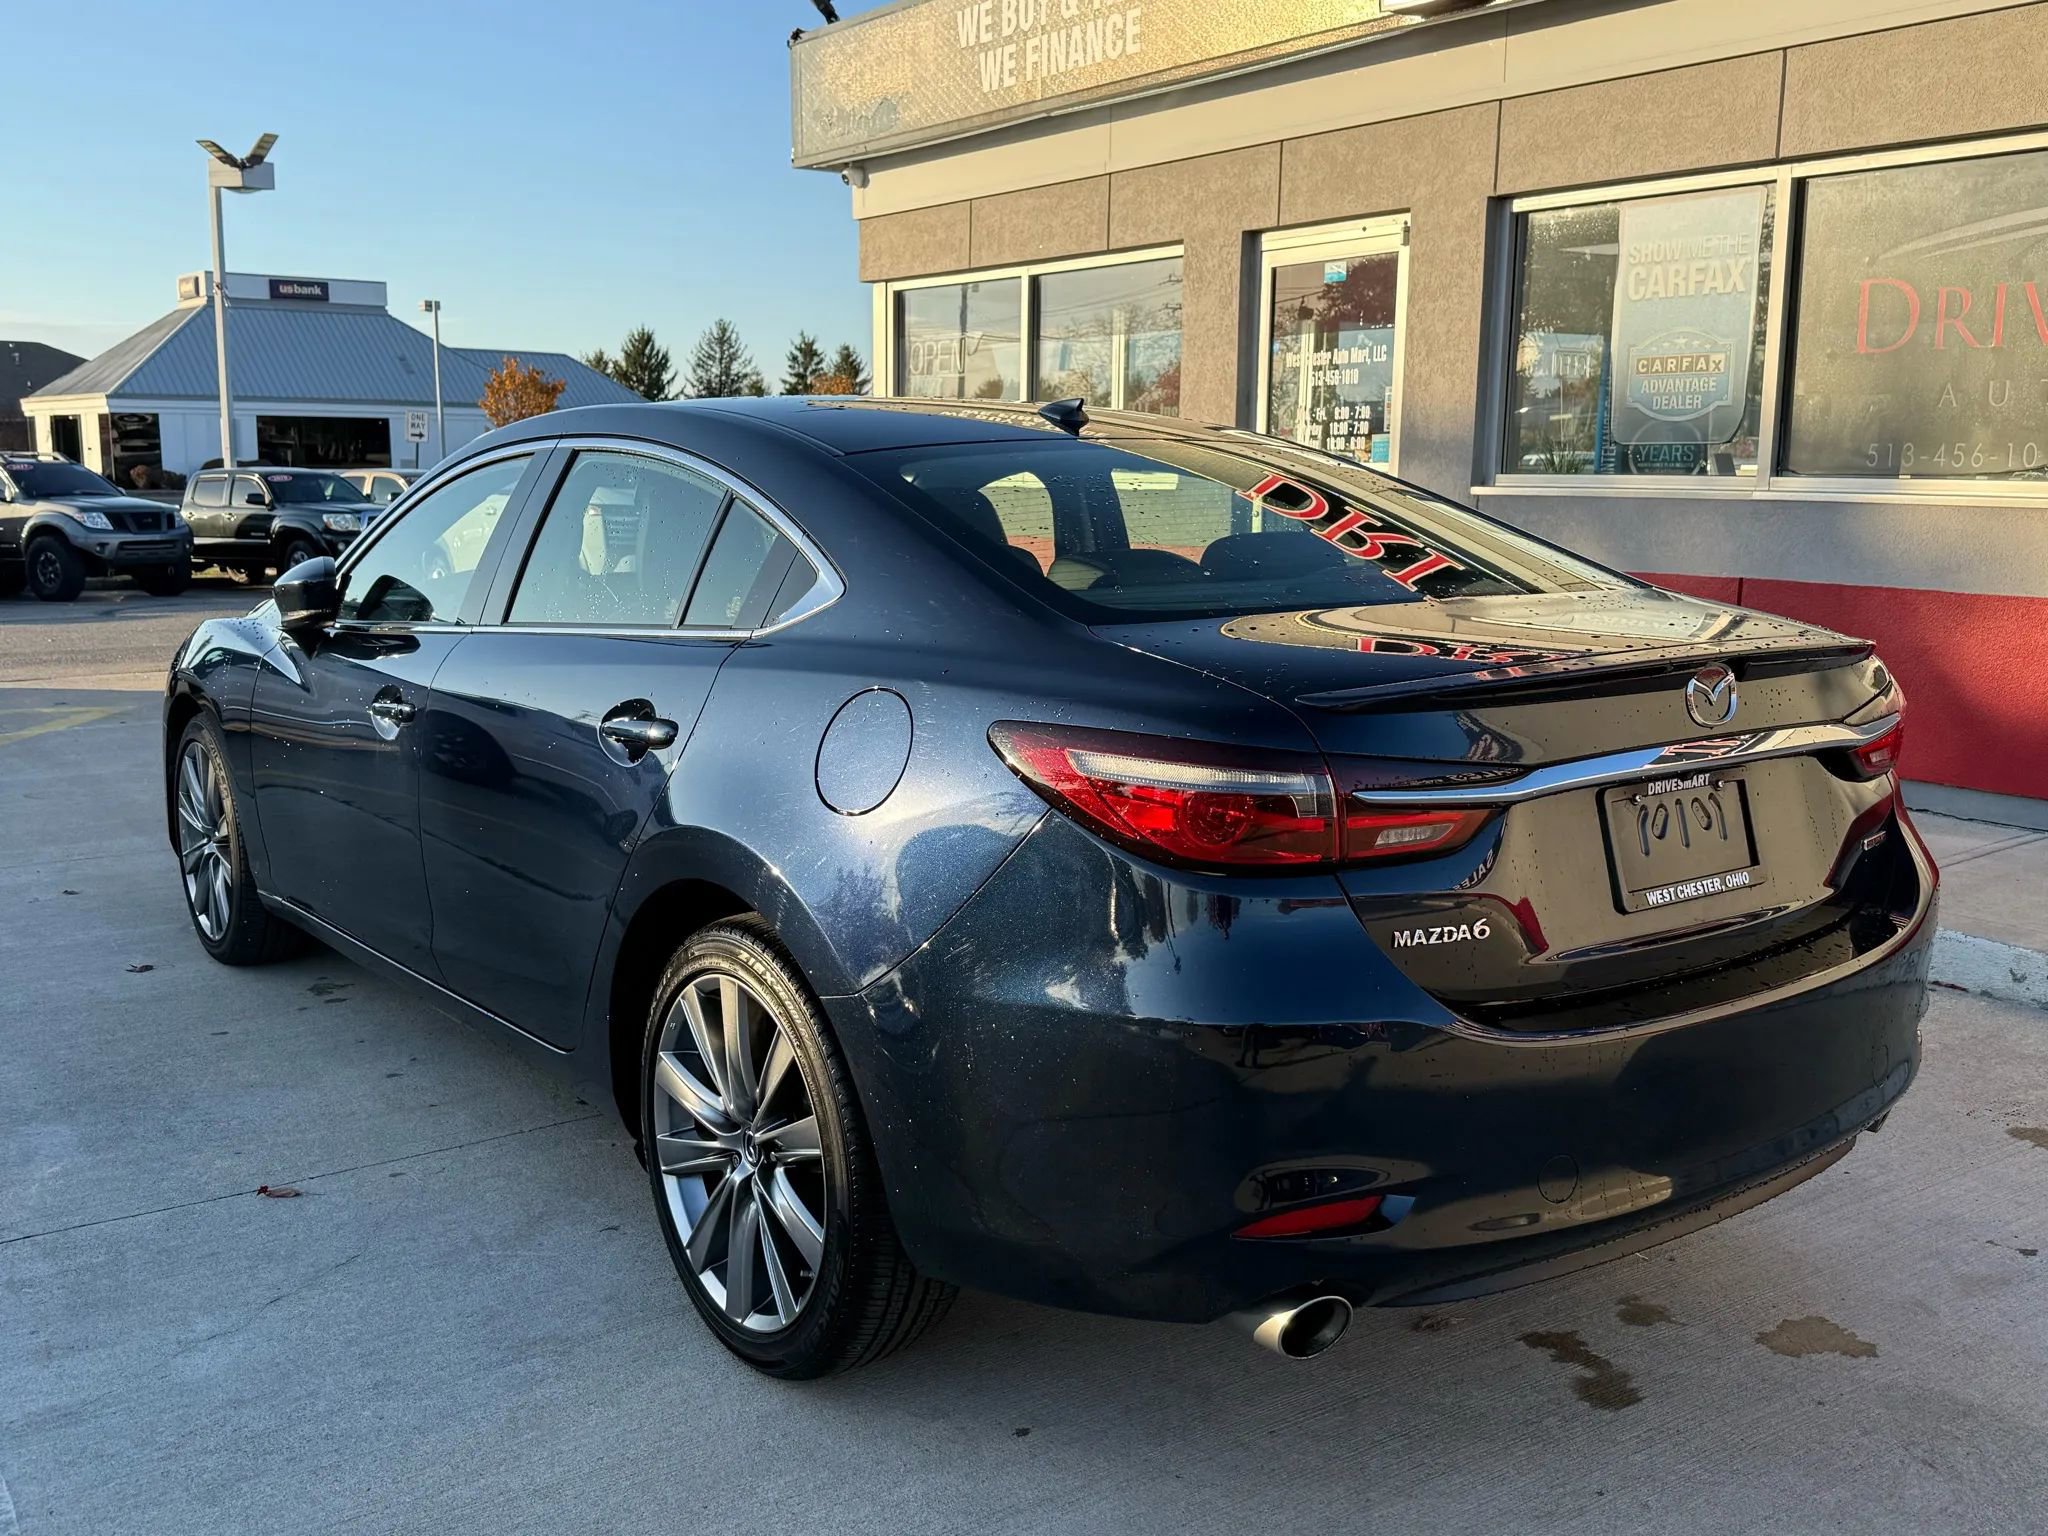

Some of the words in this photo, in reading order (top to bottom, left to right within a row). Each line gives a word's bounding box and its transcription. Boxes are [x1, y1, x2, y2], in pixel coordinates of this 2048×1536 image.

[957, 3, 993, 49] WE
[1001, 0, 1047, 37] BUY
[979, 43, 1017, 93] WE
[1025, 8, 1142, 82] FINANCE
[1628, 240, 1681, 265] SHOW
[1688, 236, 1712, 259] ME
[1715, 233, 1749, 256] THE
[1627, 257, 1752, 301] CARFAX
[910, 340, 966, 375] OPEN
[1373, 344, 1387, 362] LLC
[1638, 357, 1722, 373] CARFAX
[1641, 377, 1717, 394] ADVANTAGE
[1652, 394, 1702, 410] DEALER
[1640, 445, 1694, 461] YEARS
[1866, 443, 2037, 467] 513-456-10
[1646, 886, 1676, 906] WEST
[1676, 877, 1726, 899] CHESTER,
[1727, 871, 1750, 887] OHIO
[1393, 918, 1490, 948] MAZDA6
